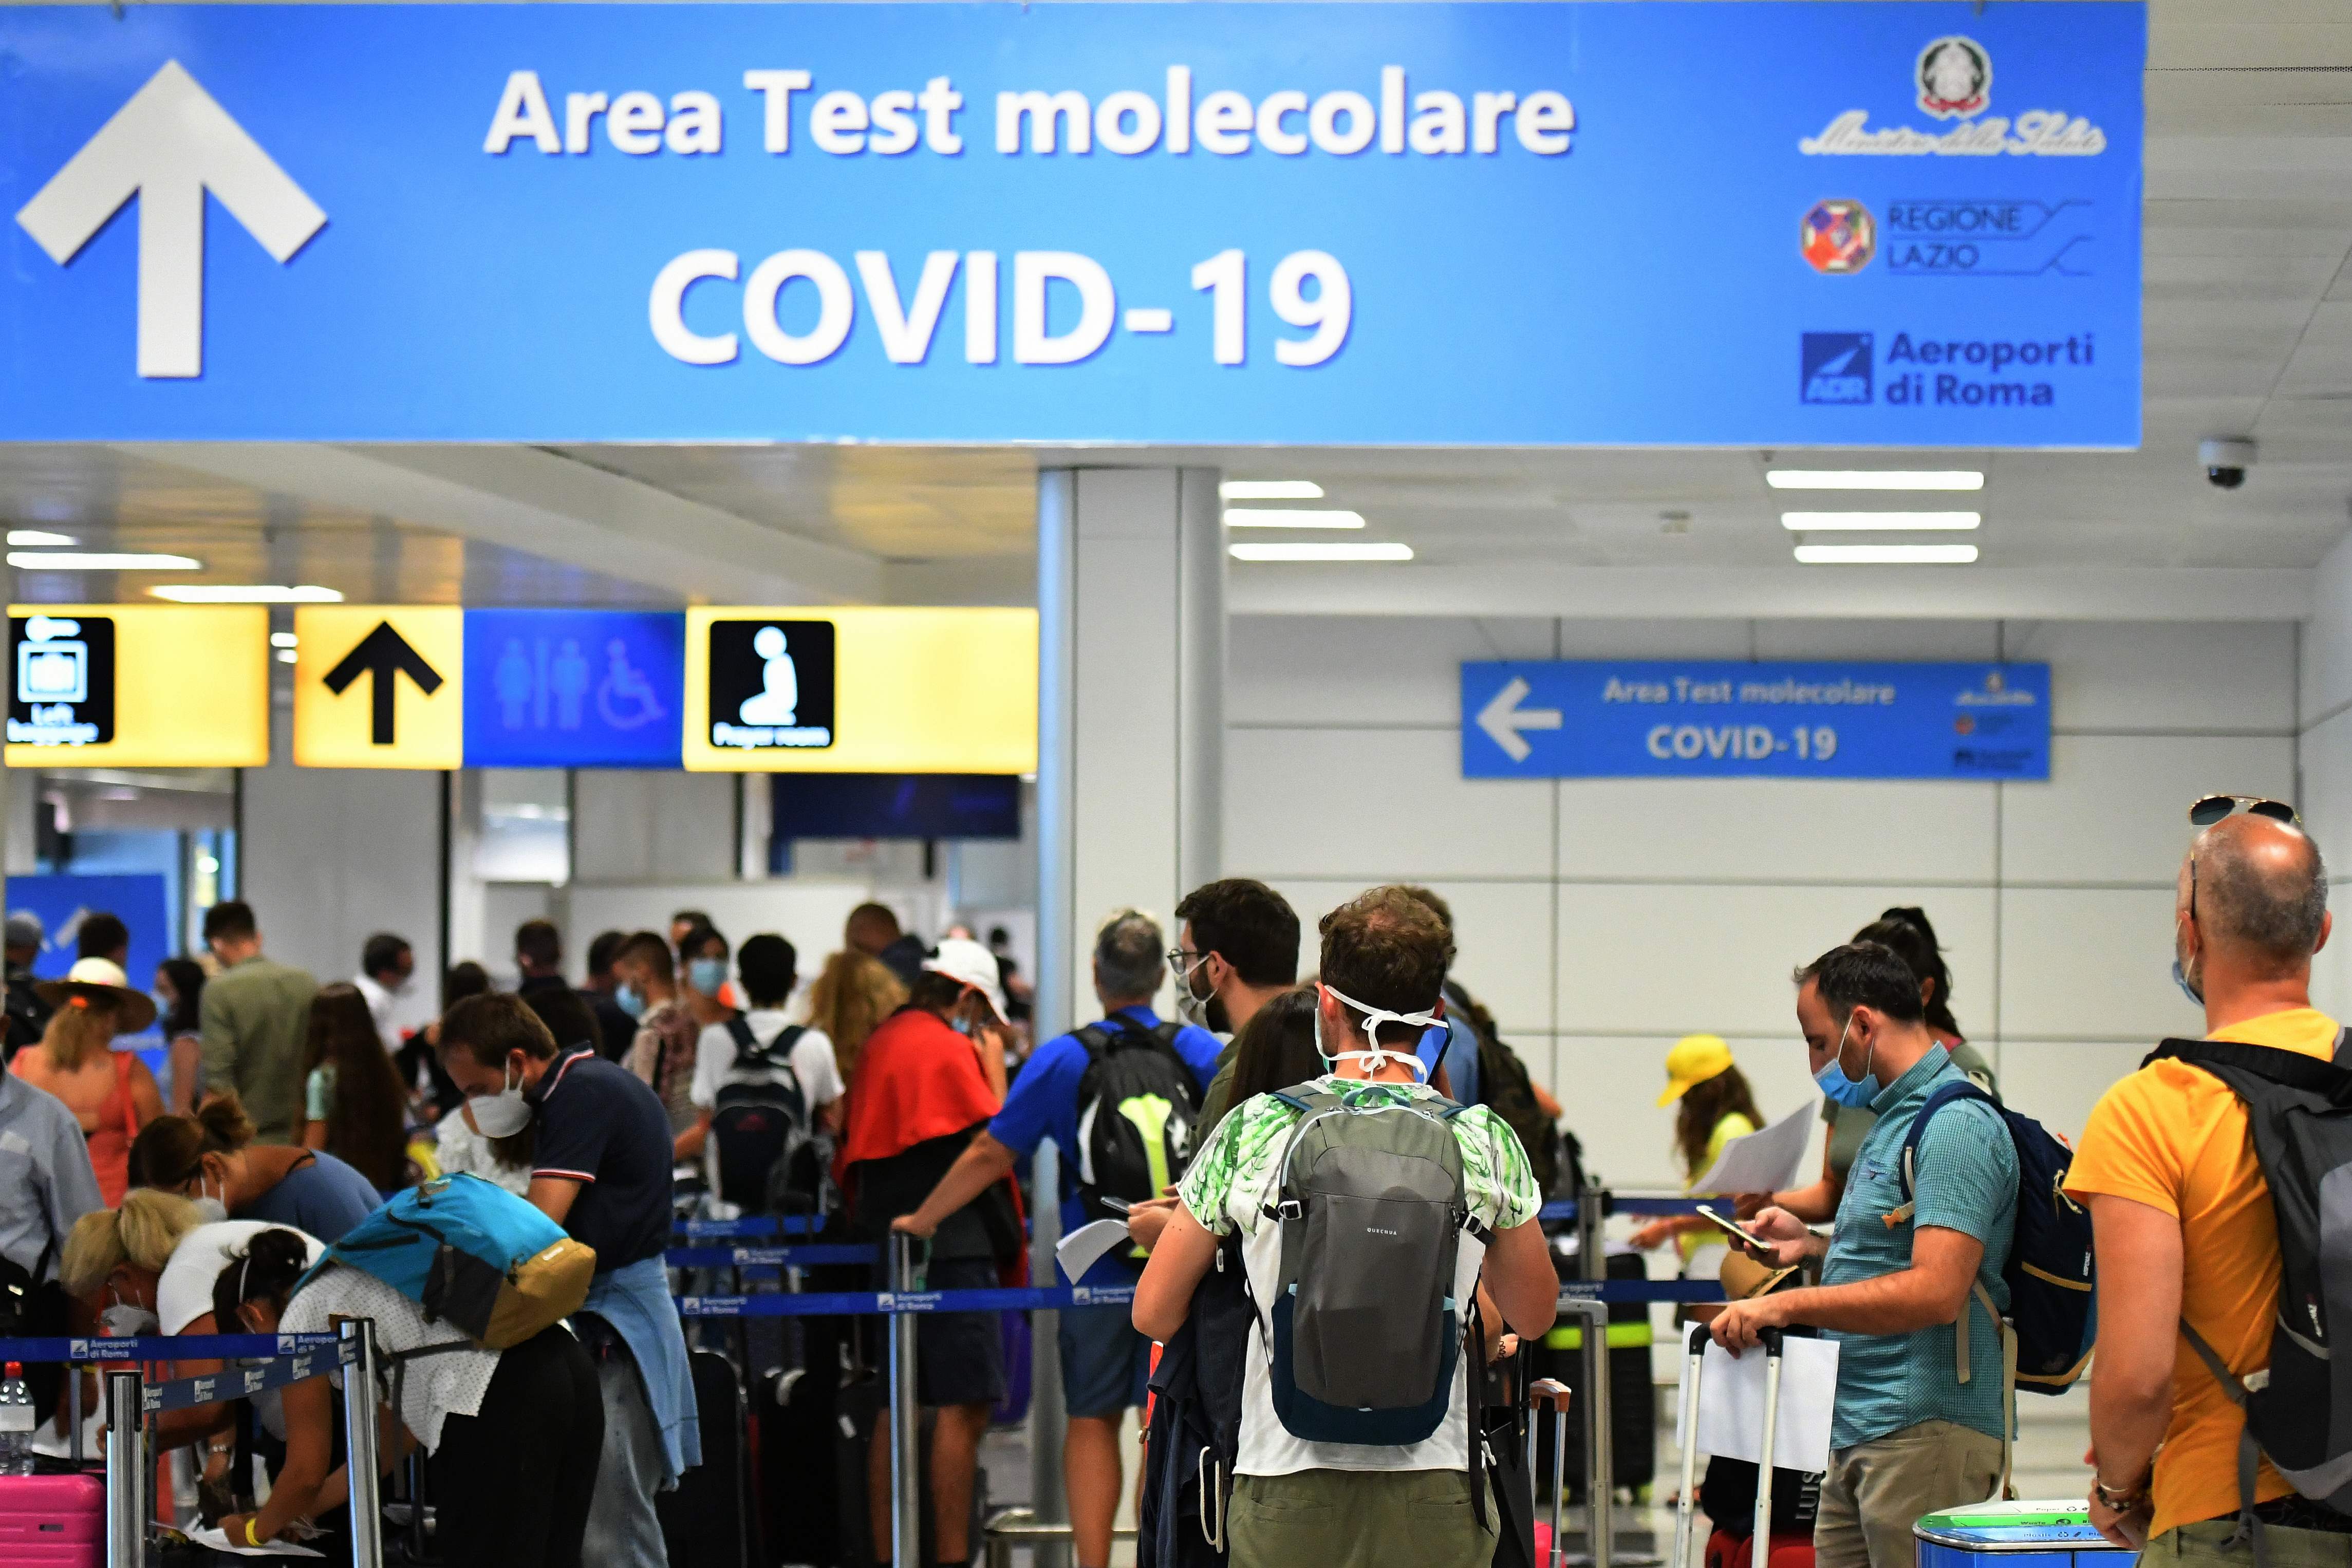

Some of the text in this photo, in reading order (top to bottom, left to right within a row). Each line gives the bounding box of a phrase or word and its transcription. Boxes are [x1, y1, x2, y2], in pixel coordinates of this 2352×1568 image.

[484, 64, 1575, 155] Area Test molecolare
[1888, 204, 2020, 231] REGIONE
[1888, 244, 1980, 269] LAZIO
[649, 249, 1352, 366] COVID-19
[1887, 332, 2094, 373] Aeroporti
[1886, 374, 2054, 405] di Roma
[1602, 677, 1896, 705] Area Test molecolare
[774, 726, 830, 746] room
[1647, 724, 1838, 761] COVID-19
[1367, 1227, 1397, 1236] QUECHUA
[90, 1339, 138, 1349] Aeroporti
